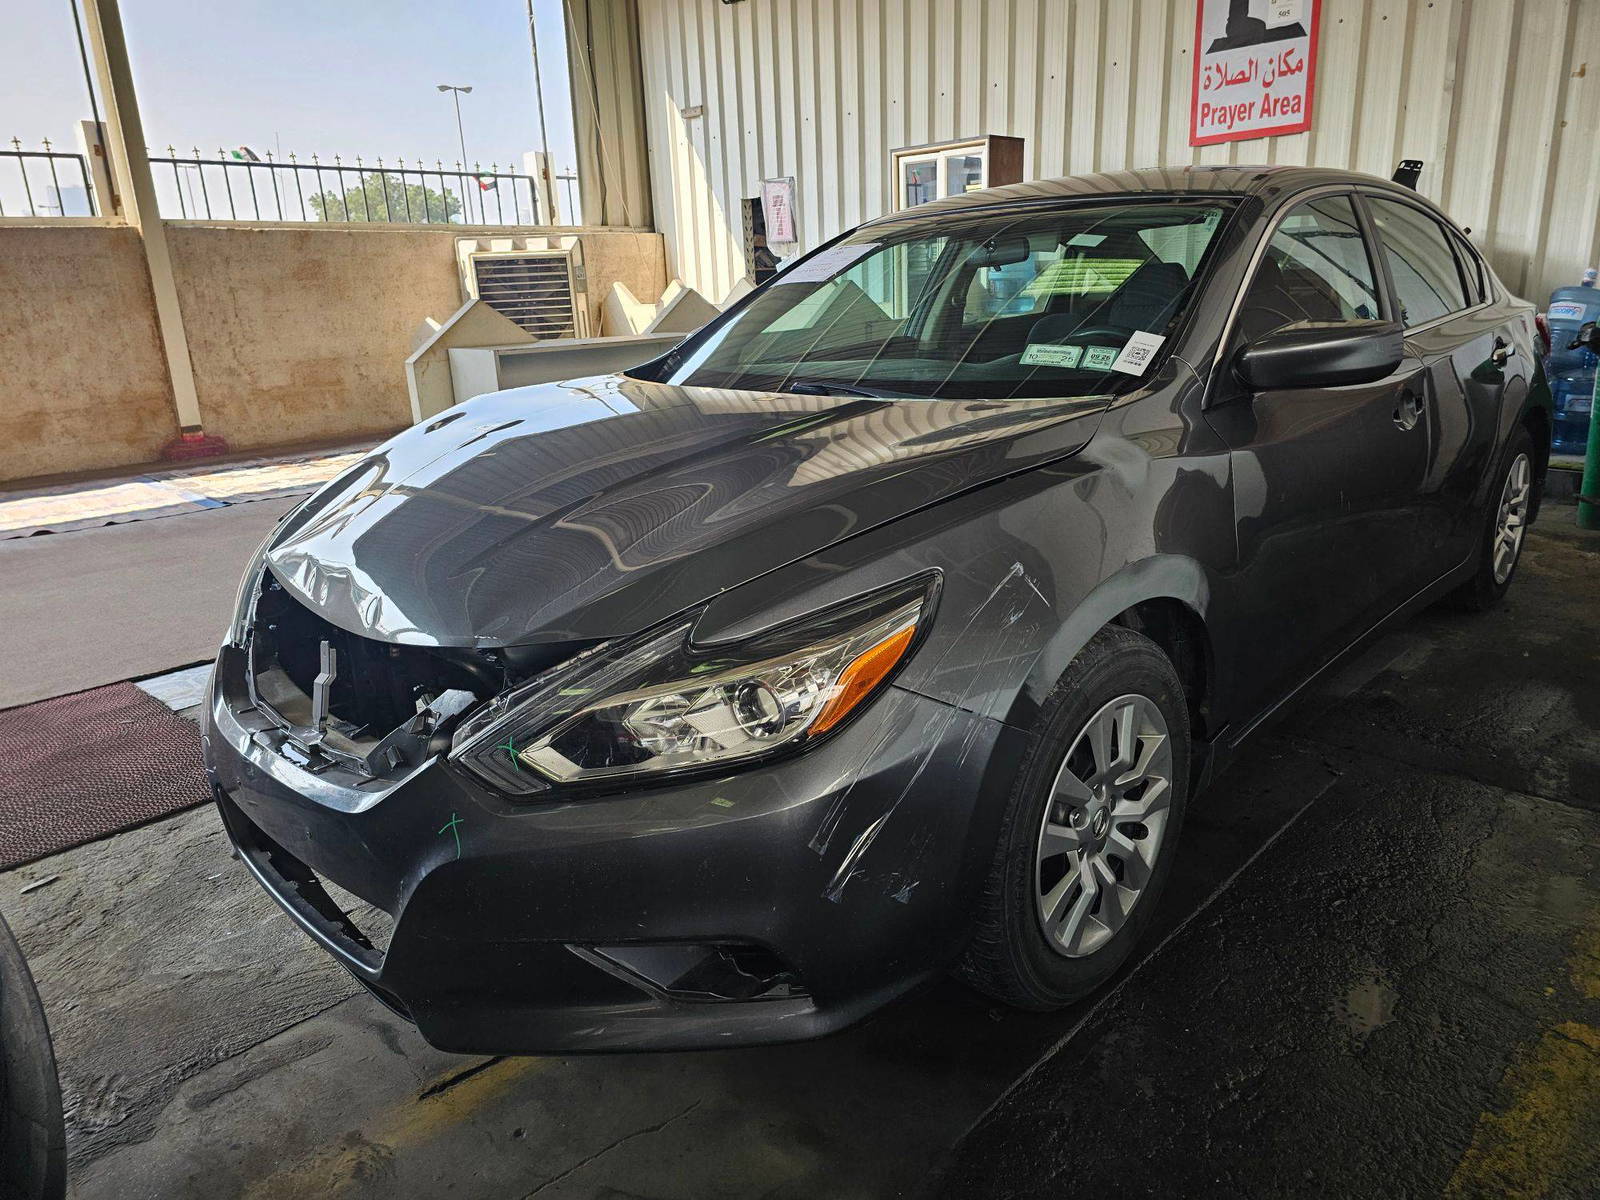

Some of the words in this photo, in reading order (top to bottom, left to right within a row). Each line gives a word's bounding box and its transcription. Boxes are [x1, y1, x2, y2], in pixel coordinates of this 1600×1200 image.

[1203, 58, 1259, 91] الصلاة
[1262, 48, 1304, 89] مكان
[1201, 101, 1255, 130] Prayer
[1259, 93, 1302, 119] Area
